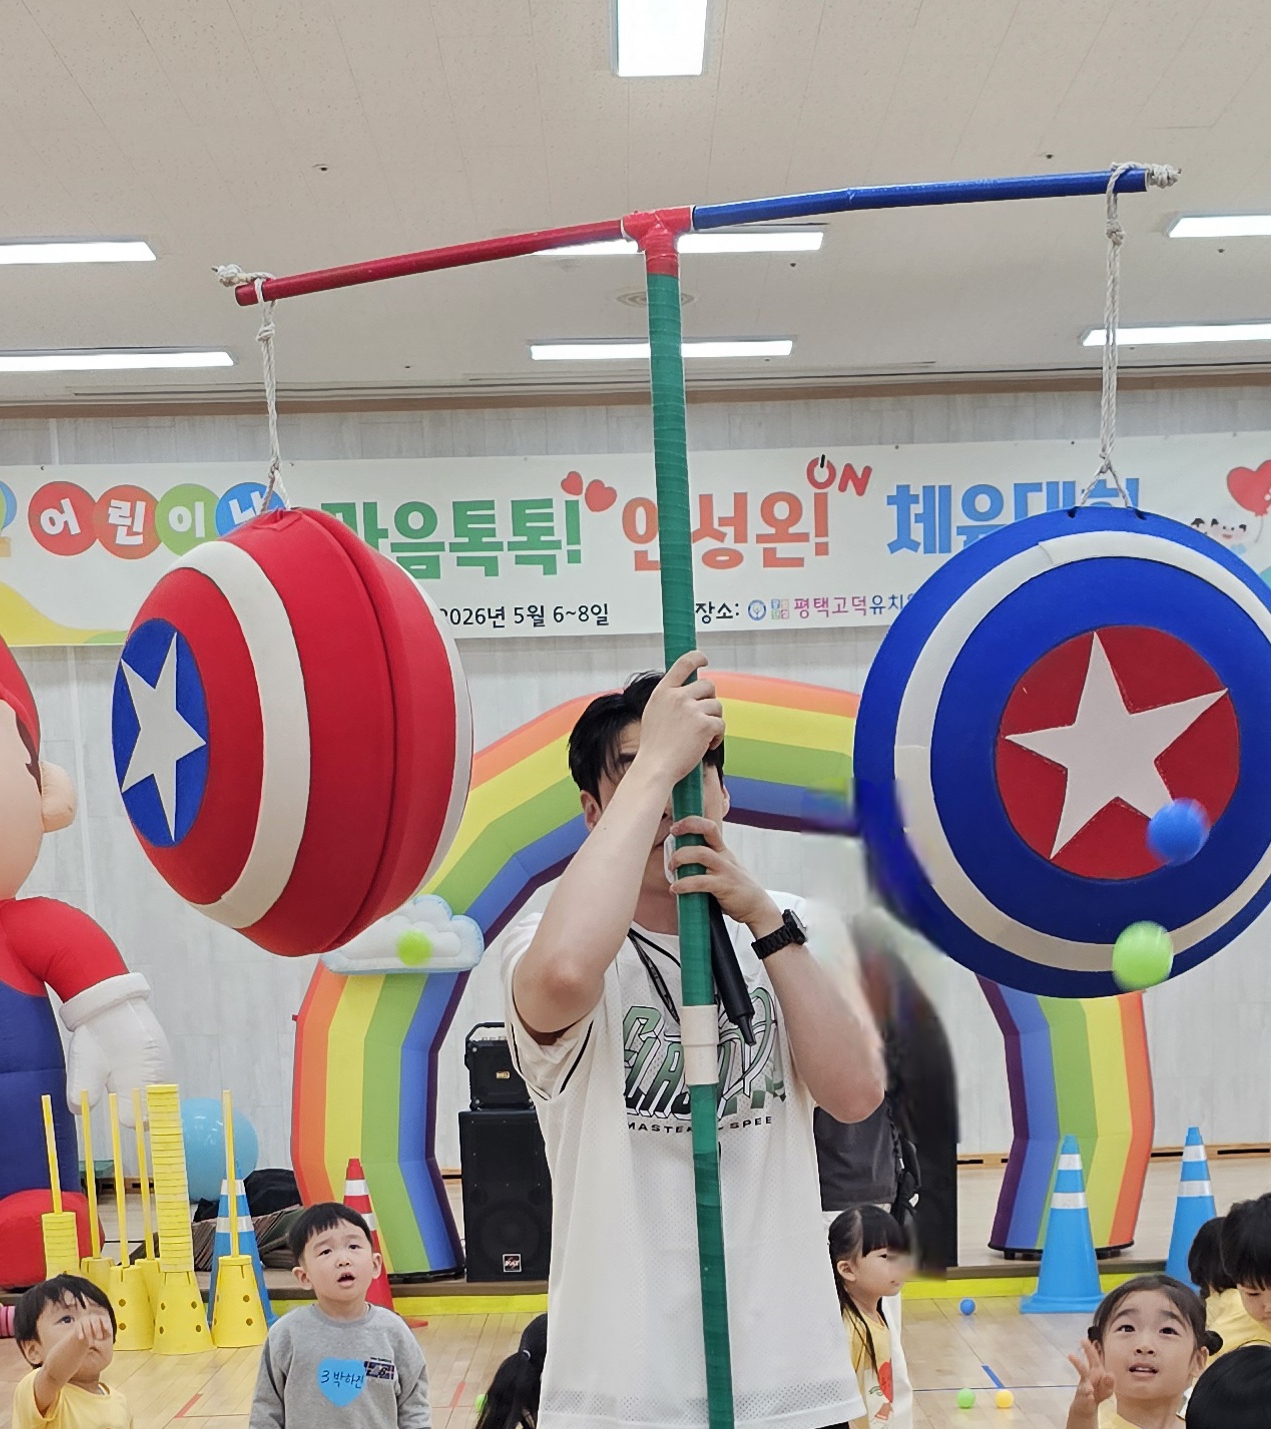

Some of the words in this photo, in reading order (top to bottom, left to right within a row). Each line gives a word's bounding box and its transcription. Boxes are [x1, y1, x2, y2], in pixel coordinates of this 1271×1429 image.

[807, 454, 873, 497] ON
[514, 604, 546, 628] 5월
[553, 603, 609, 626] 6~8일
[695, 601, 740, 624] 장소:
